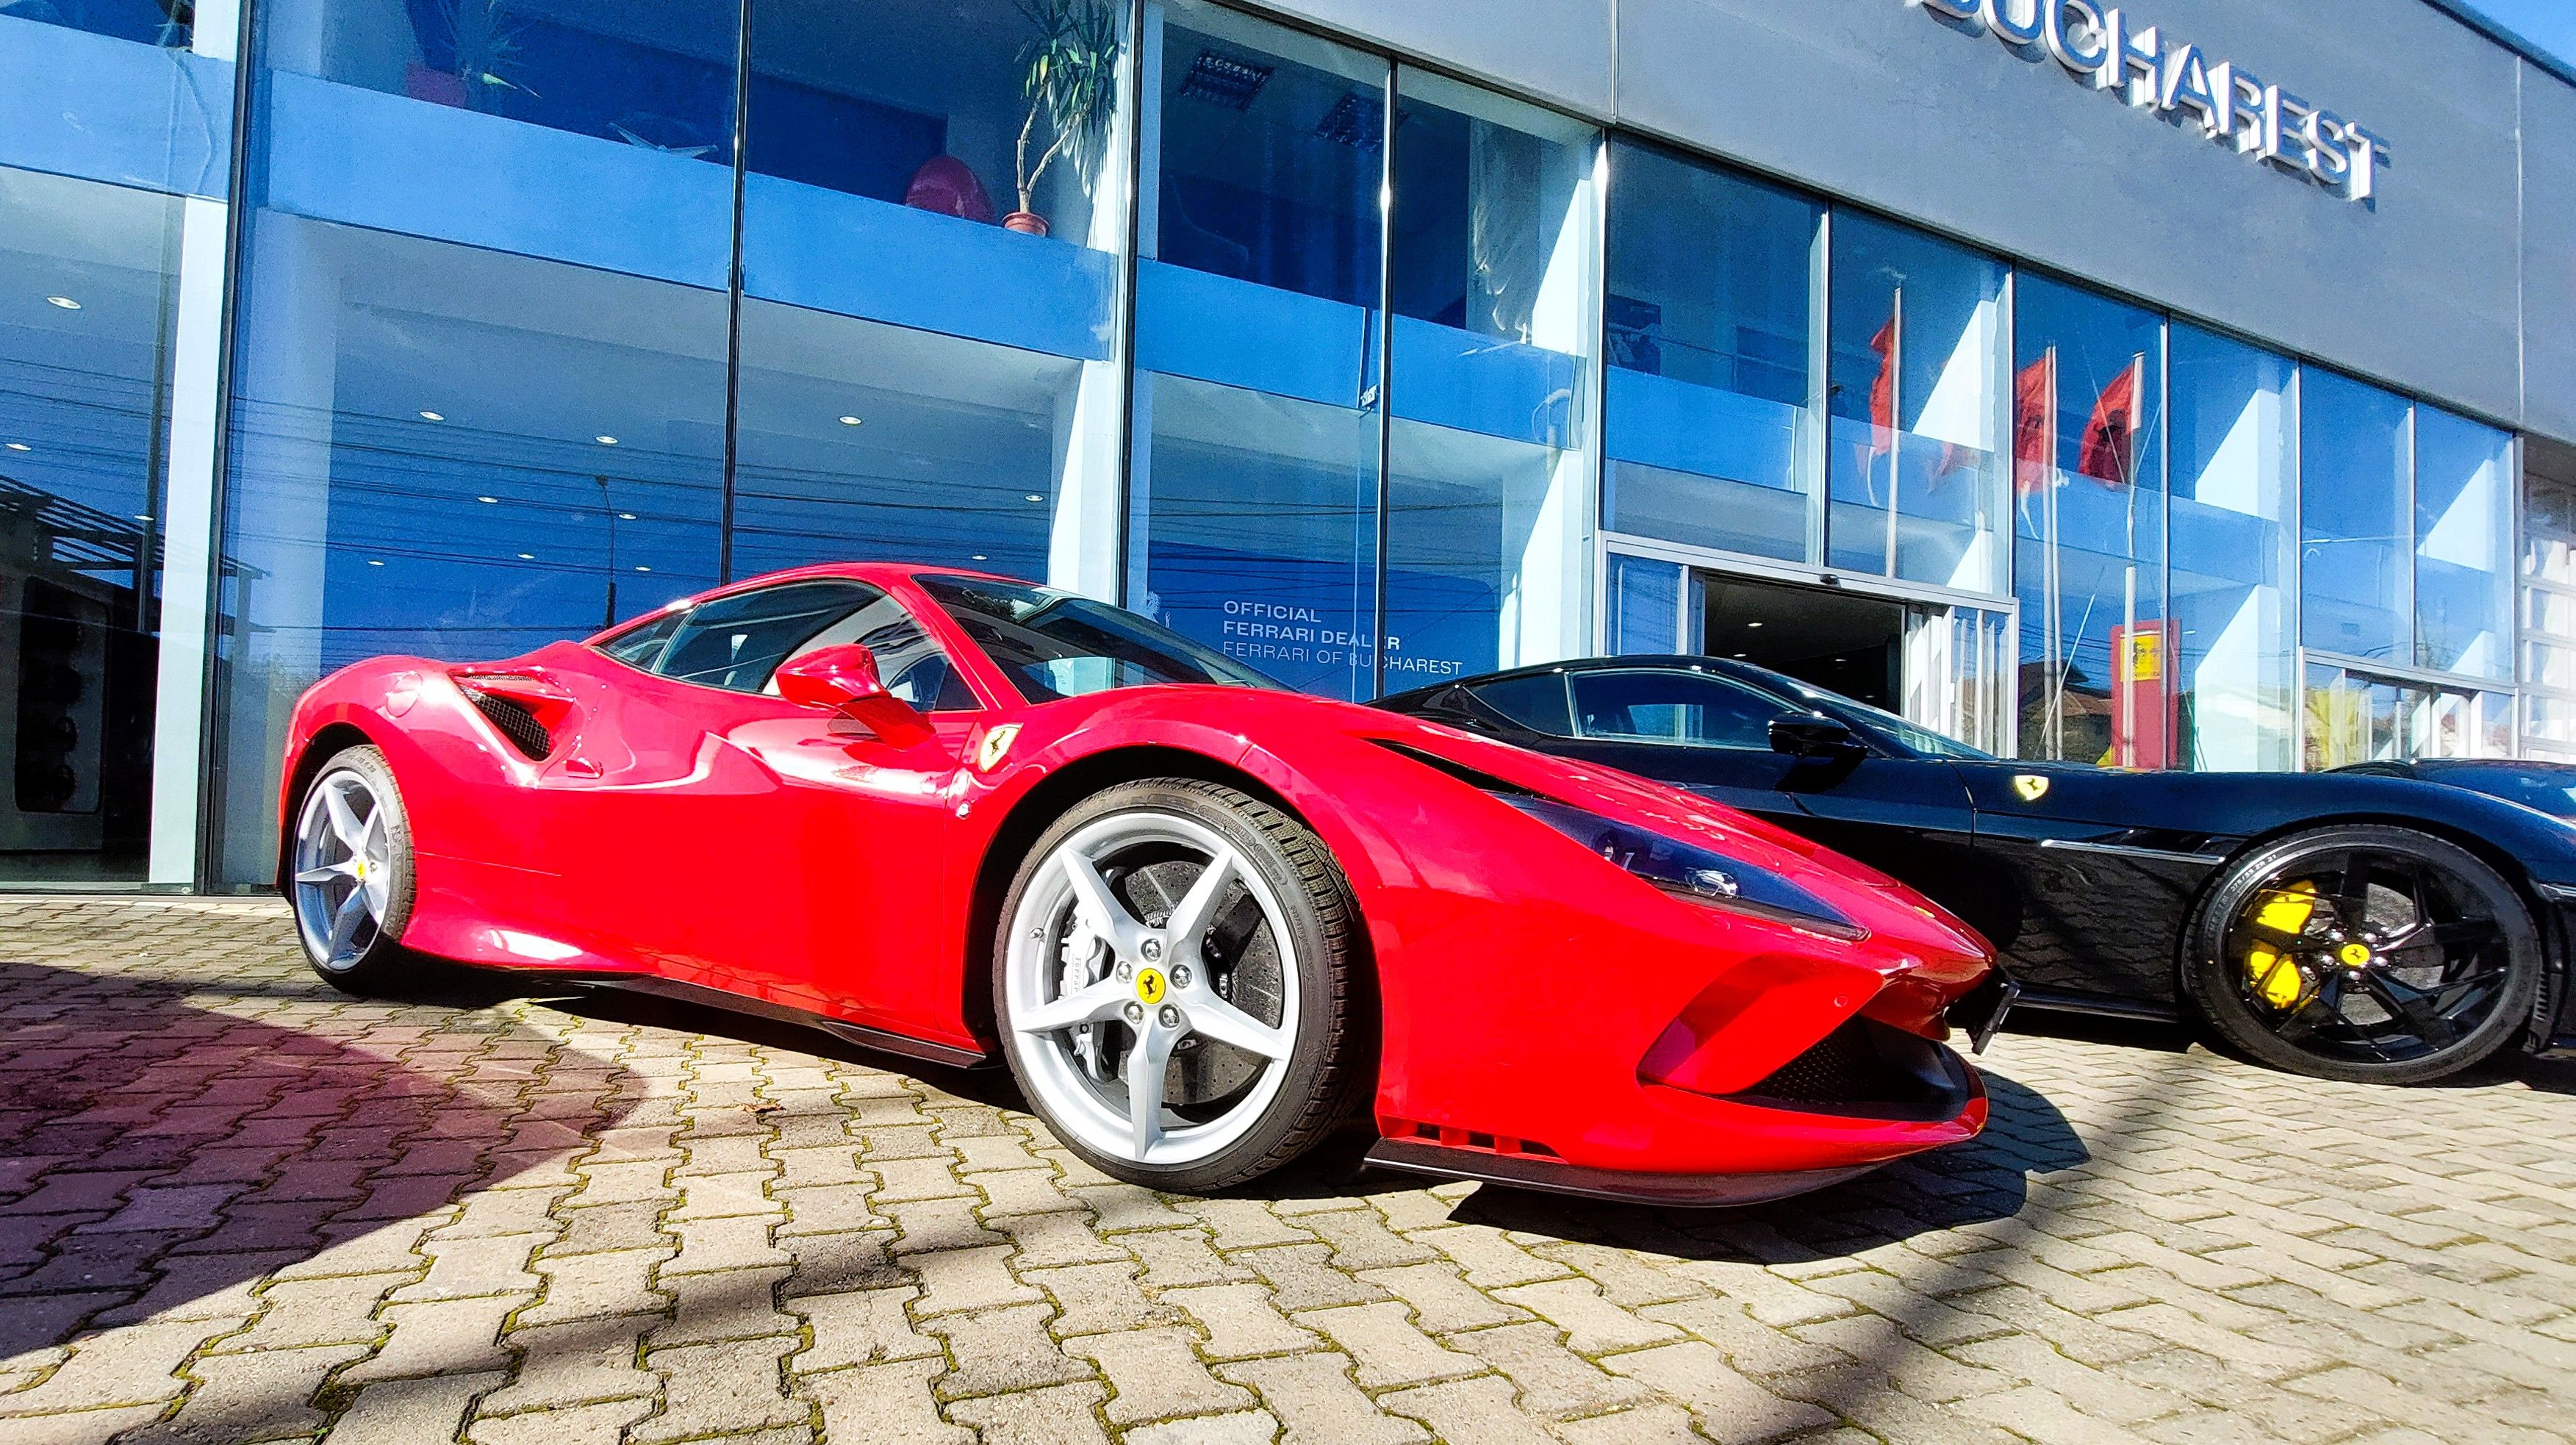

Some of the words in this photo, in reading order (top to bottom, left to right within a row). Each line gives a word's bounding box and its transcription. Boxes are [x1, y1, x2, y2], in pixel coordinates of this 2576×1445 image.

[1906, 0, 2390, 201] UCHAREST
[1224, 600, 1321, 623] OFFICIAL
[1223, 620, 1314, 642] FERRARI
[1321, 630, 1399, 650] DEALR
[1223, 641, 1309, 662] FERRARI
[1316, 650, 1343, 664] OF
